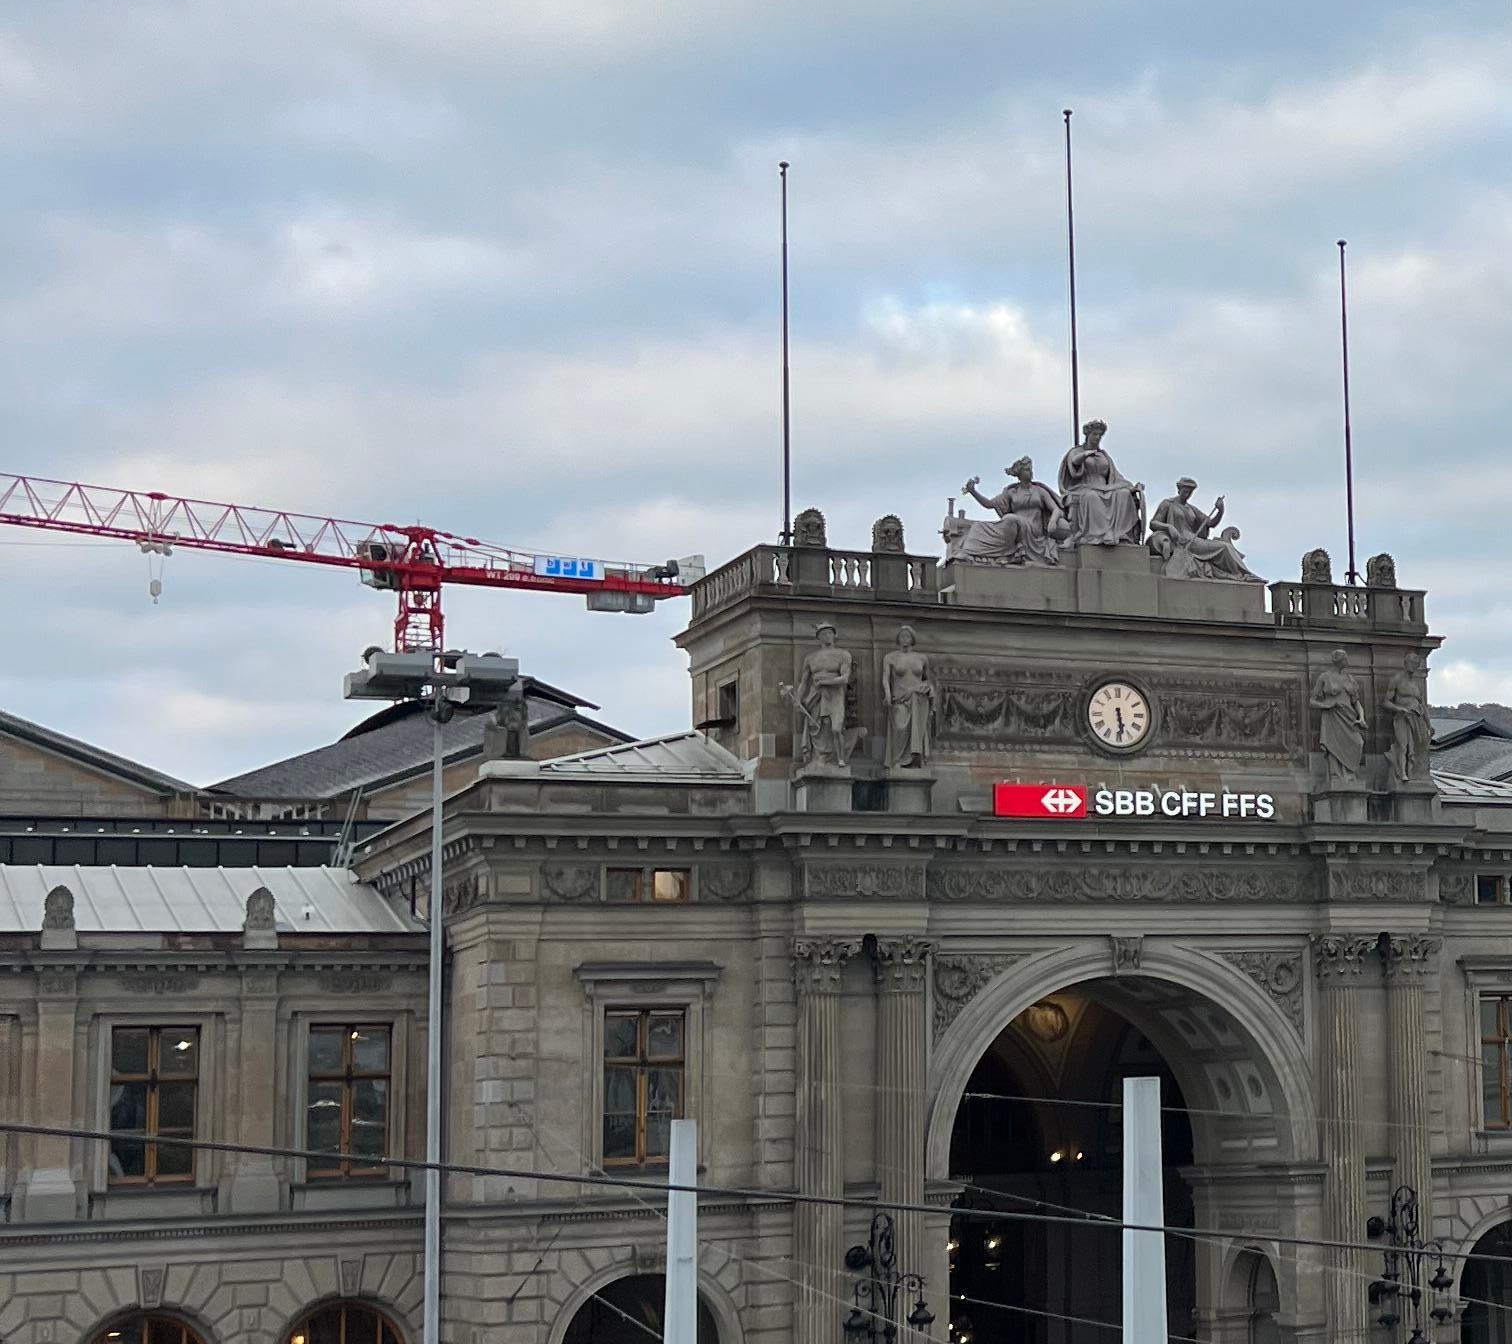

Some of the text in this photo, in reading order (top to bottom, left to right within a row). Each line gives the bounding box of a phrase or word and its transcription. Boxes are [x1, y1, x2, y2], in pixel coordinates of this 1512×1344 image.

[1095, 790, 1275, 819] SBB CFF FFS
